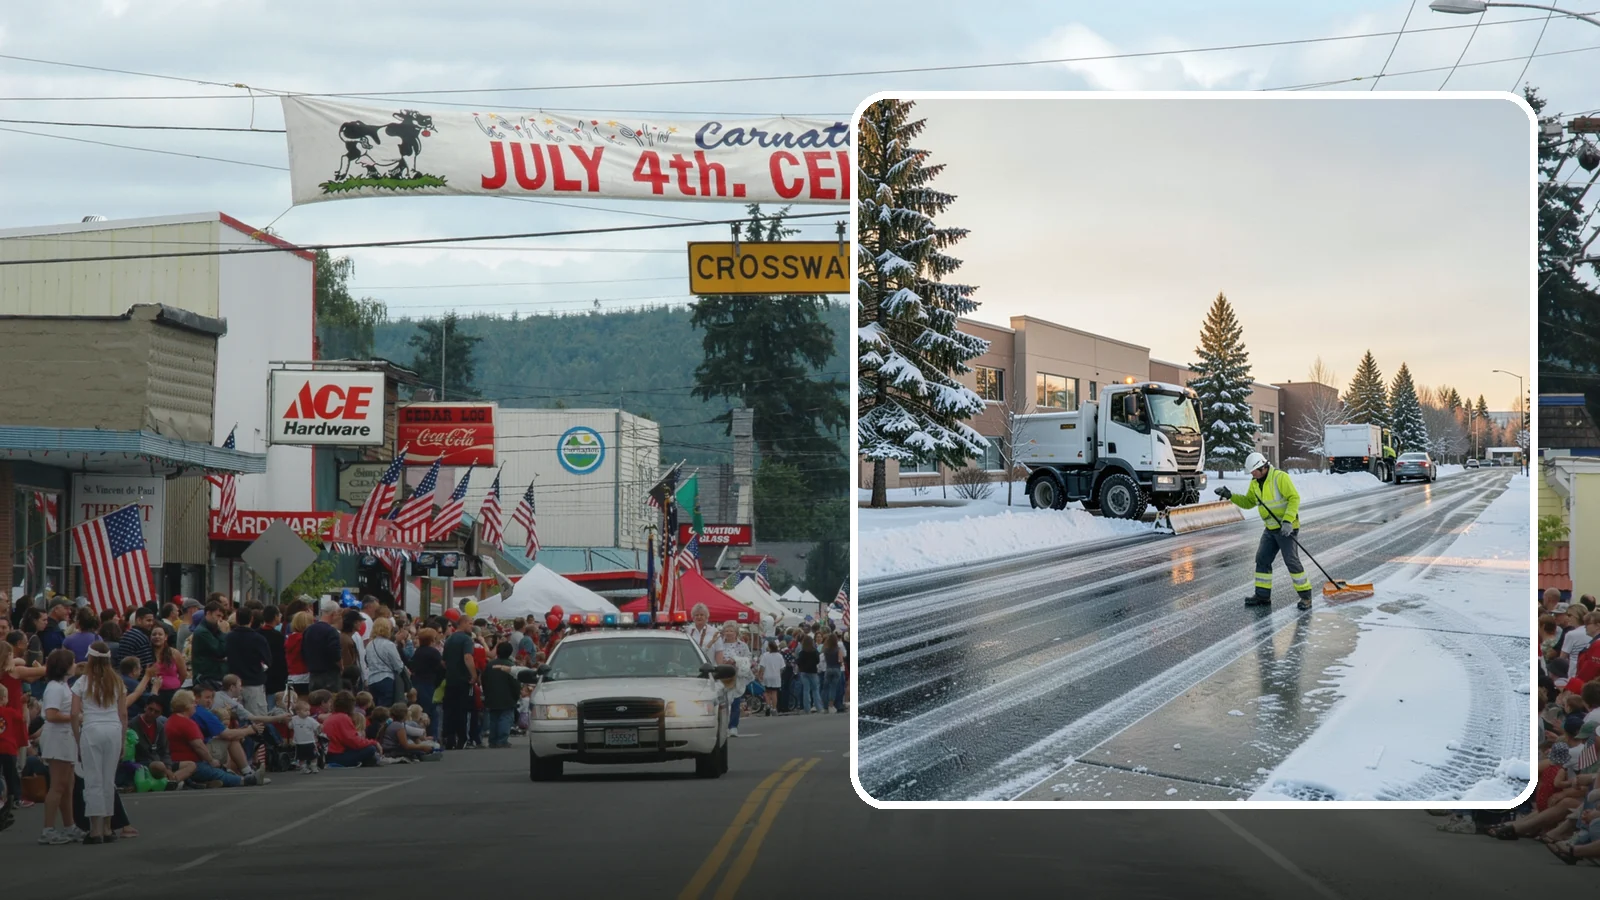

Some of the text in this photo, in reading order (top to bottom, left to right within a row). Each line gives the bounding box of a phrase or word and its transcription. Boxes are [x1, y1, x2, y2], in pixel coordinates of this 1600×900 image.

[481, 141, 605, 192] JULY
[632, 149, 746, 197] 4th.
[697, 254, 850, 280] CROSSWA
[283, 380, 373, 419] ACE
[406, 409, 484, 421] CEDAR LOG
[283, 421, 370, 436] Hardware
[416, 428, 476, 447] Coca-Cola
[353, 467, 386, 480] Simpl
[96, 485, 124, 495] Vincent
[126, 486, 136, 494] de
[138, 486, 155, 495] Paul
[688, 526, 741, 535] CRNATION
[699, 535, 730, 543] GLASS
